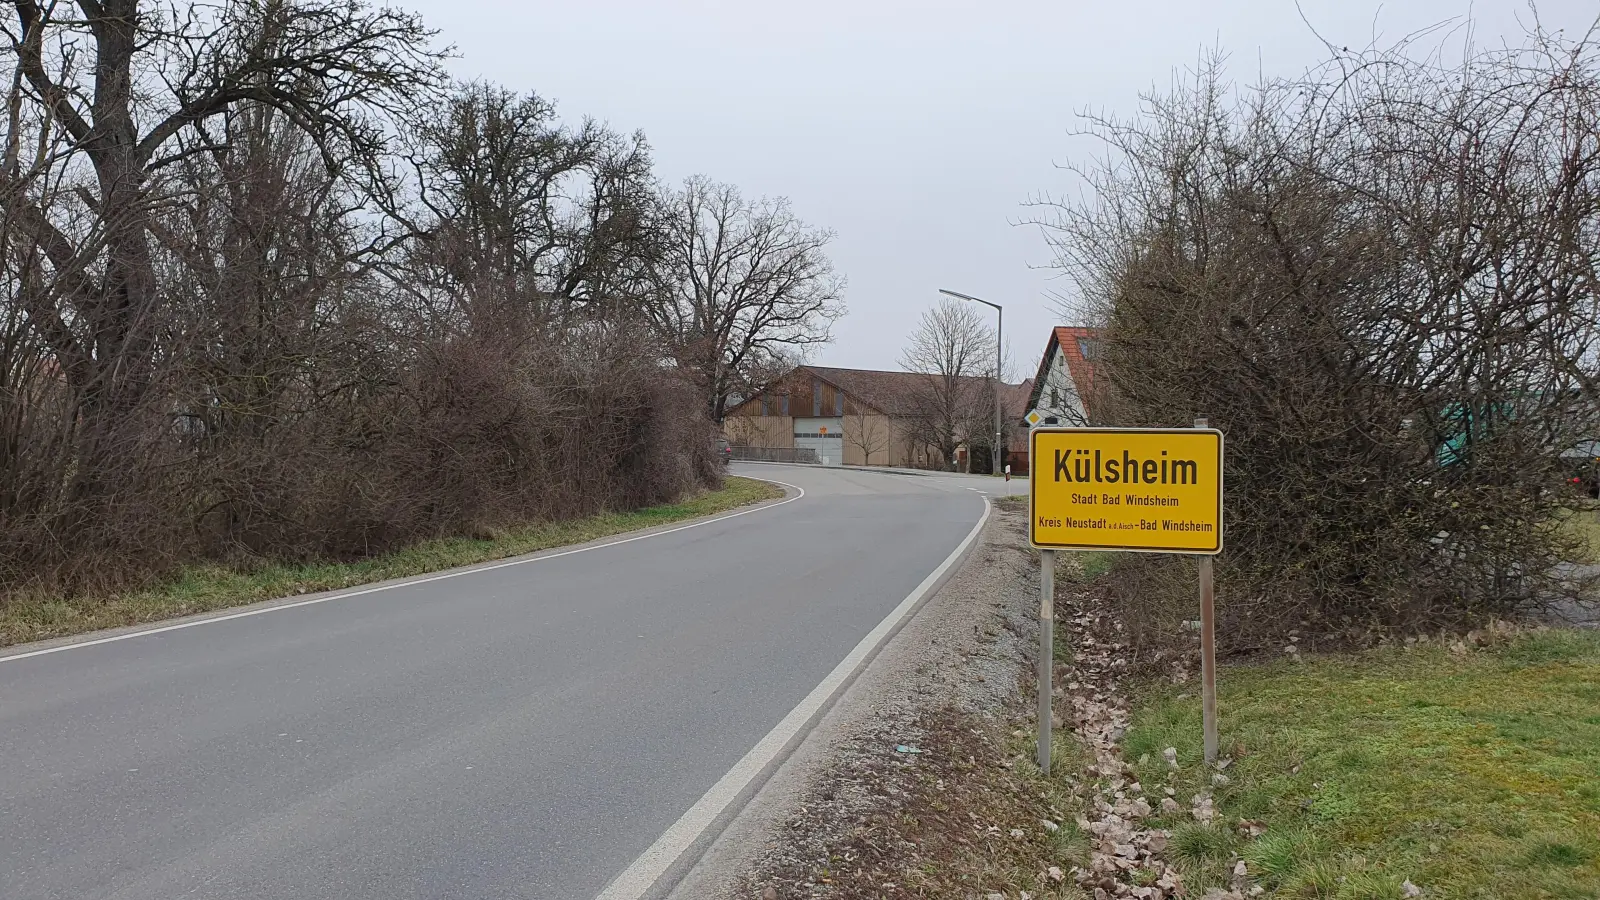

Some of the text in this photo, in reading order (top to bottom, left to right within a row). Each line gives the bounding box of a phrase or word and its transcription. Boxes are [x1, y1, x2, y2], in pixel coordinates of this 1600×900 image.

[1054, 449, 1198, 485] Külsheim
[1071, 492, 1180, 507] Stadt Bad Windsheim
[1038, 515, 1062, 528] Kreis
[1066, 516, 1108, 529] Neustadt
[1161, 519, 1214, 532] Windsheim
